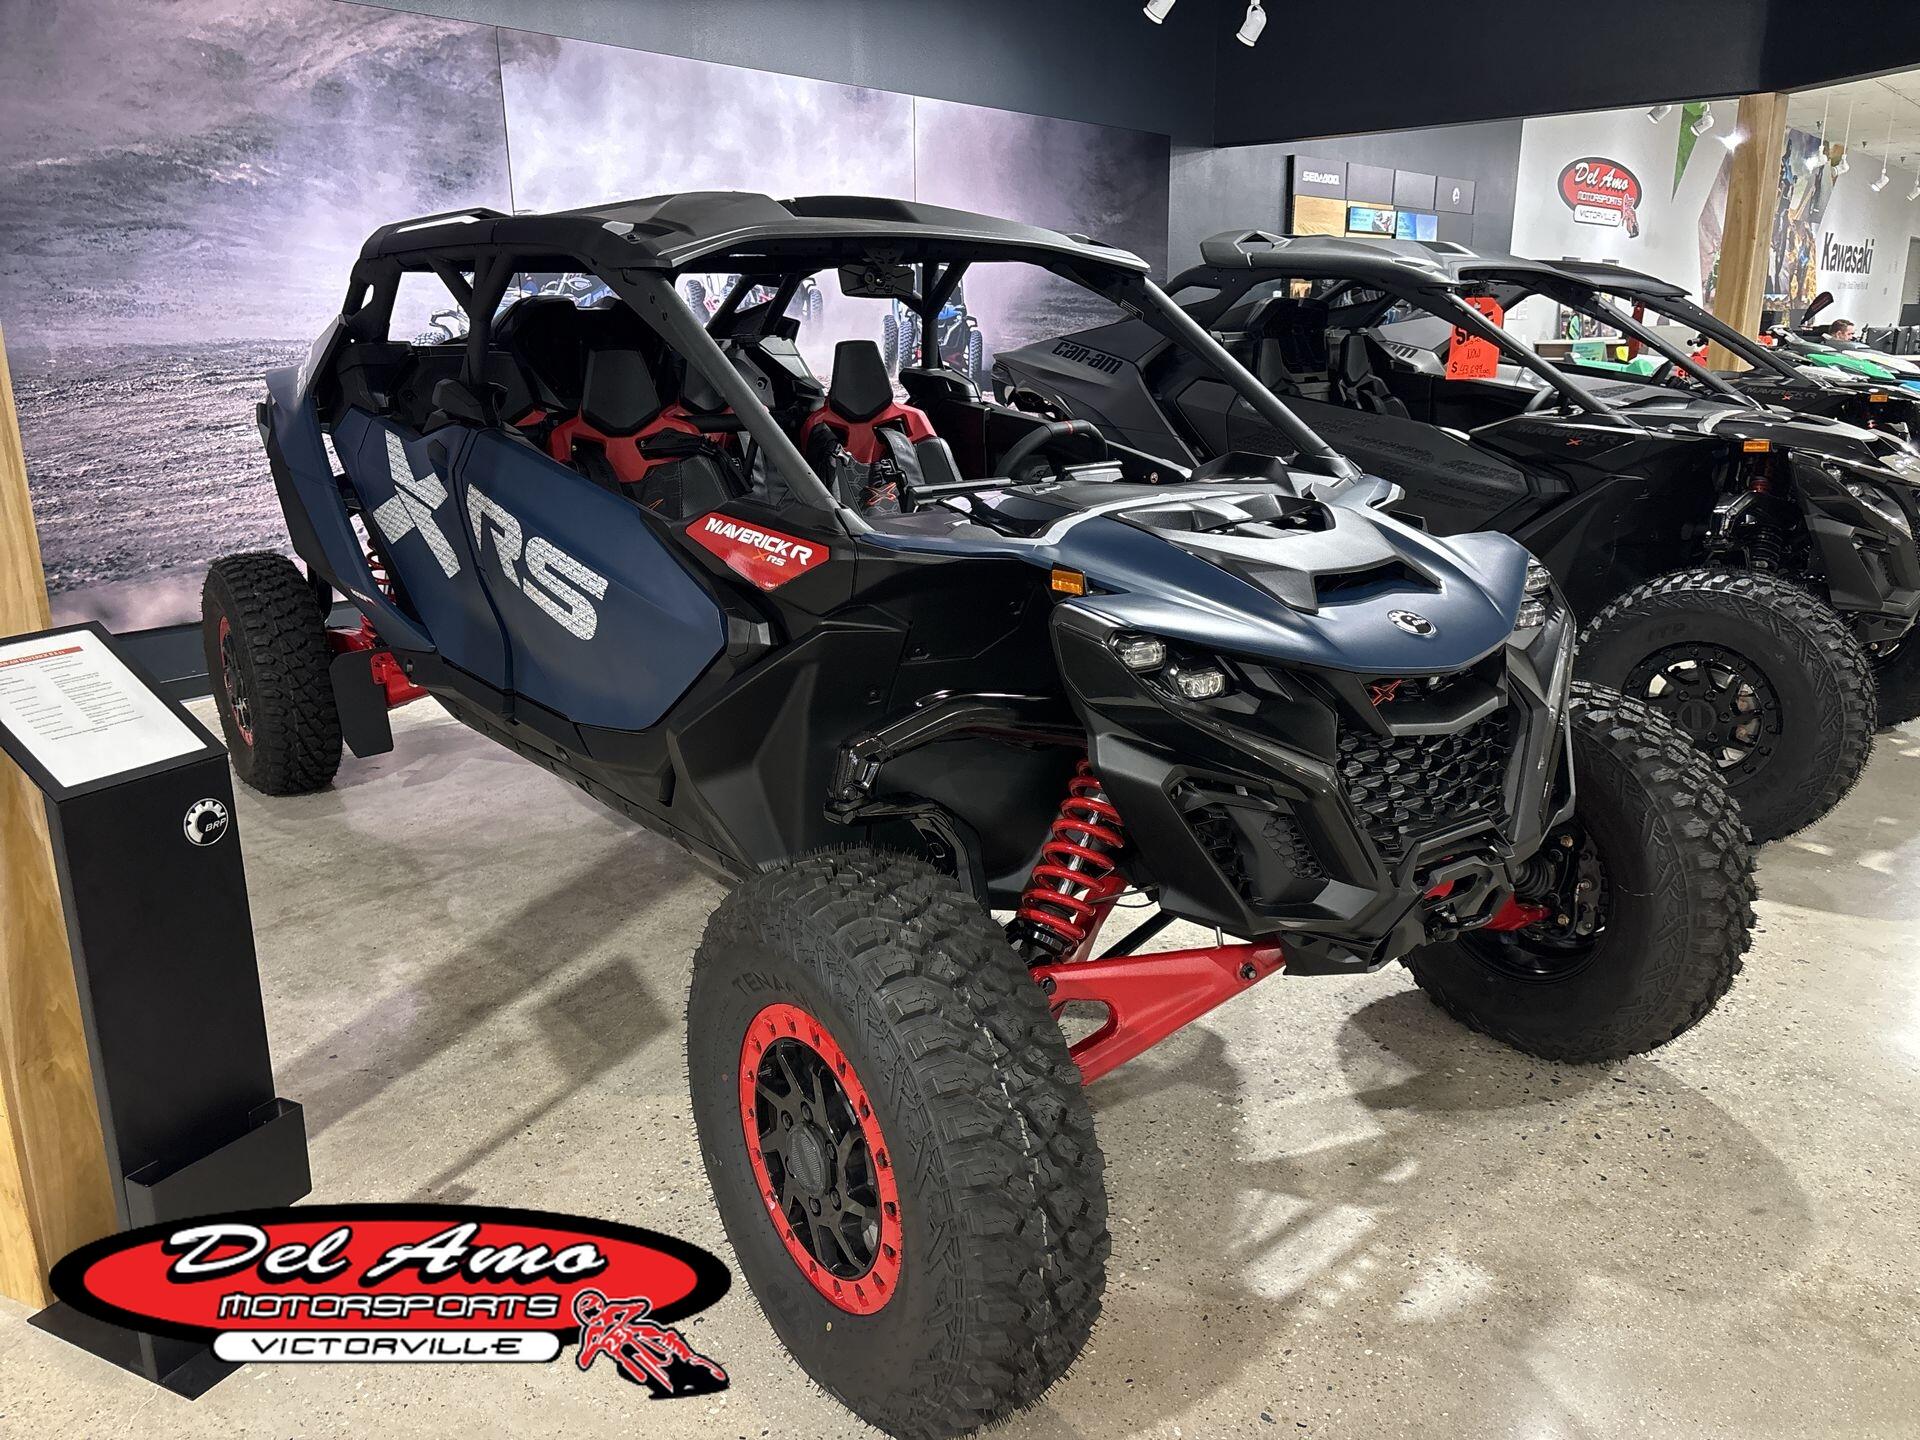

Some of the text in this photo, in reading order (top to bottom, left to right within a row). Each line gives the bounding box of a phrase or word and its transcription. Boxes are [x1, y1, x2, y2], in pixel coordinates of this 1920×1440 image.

[1574, 162, 1629, 191] Del Amo
[1577, 191, 1623, 206] MOTORSPORTS
[1821, 232, 1875, 274] Kawasaki
[1052, 341, 1124, 375] can-am
[704, 517, 813, 566] MAVERICK R
[466, 483, 609, 641] RS
[205, 817, 227, 832] BRP
